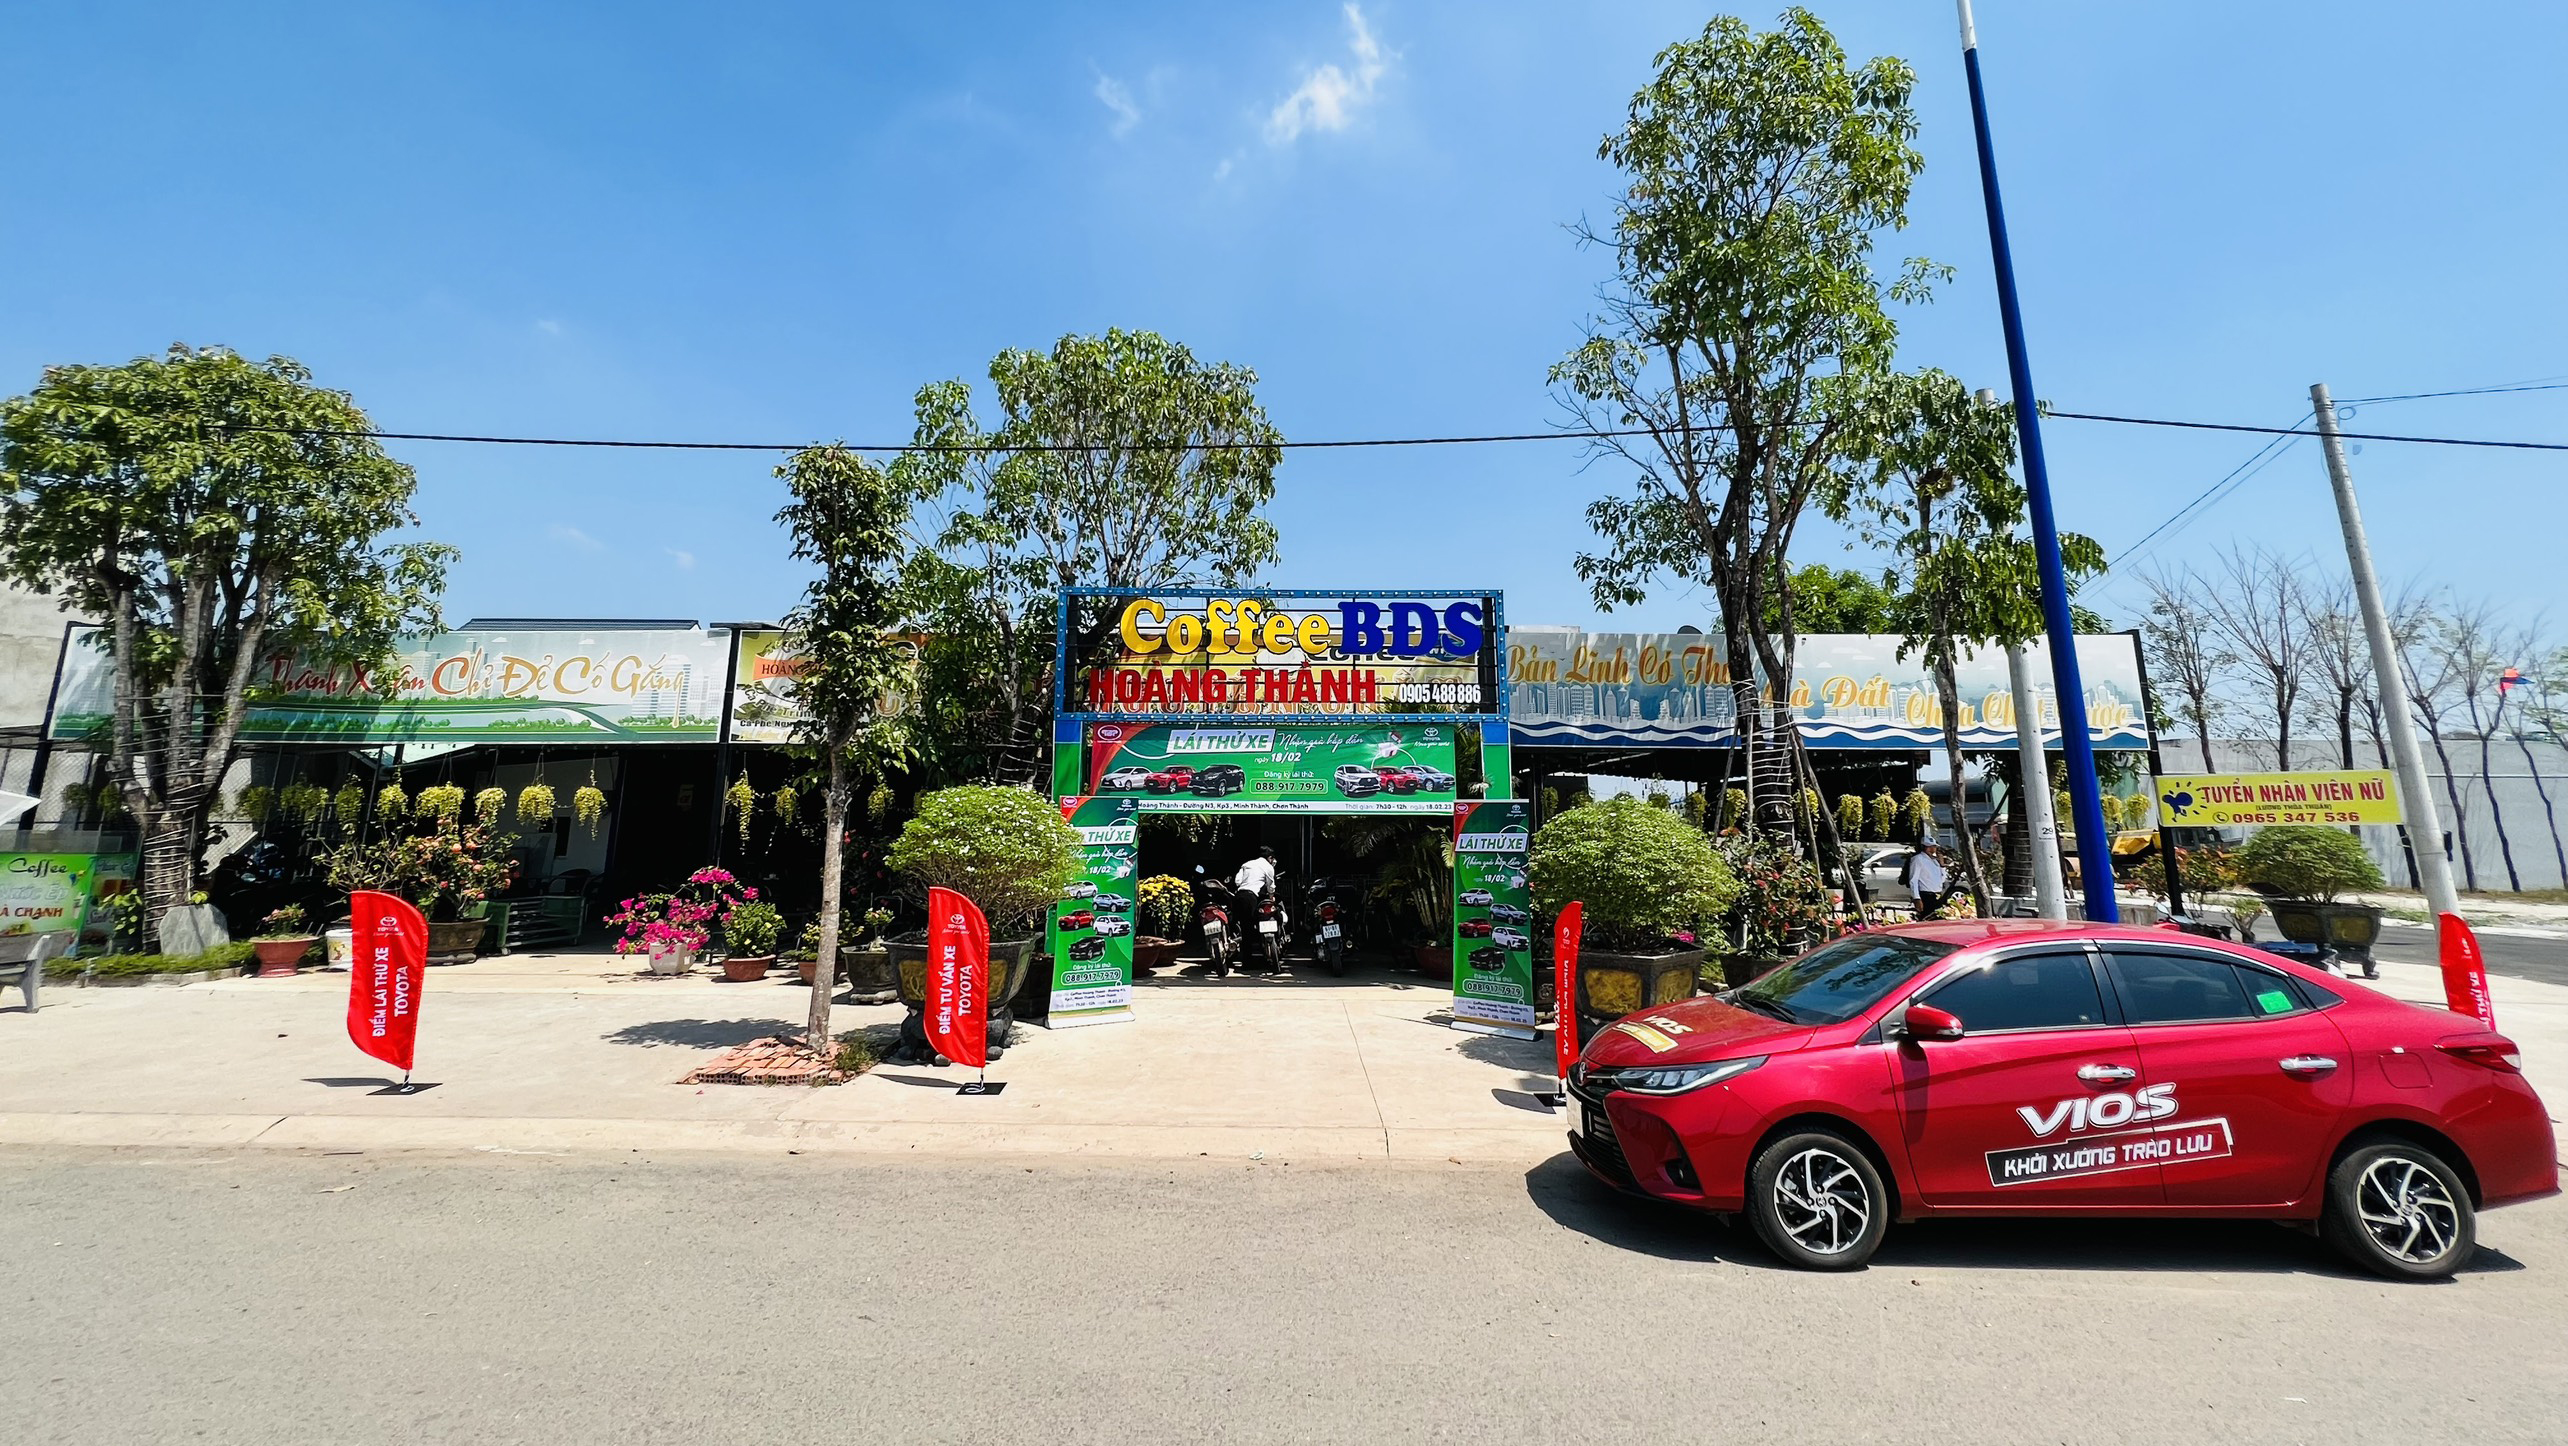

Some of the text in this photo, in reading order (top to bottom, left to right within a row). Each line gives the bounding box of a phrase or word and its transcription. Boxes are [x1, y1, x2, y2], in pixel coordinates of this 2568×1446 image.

[1120, 599, 1330, 655] Coffee
[1338, 602, 1483, 656] BĐS
[1565, 644, 1631, 684] Lĩnh
[1638, 645, 1673, 684] Có
[346, 658, 426, 696] Xân
[432, 647, 492, 695] Chỉ
[497, 654, 554, 697] Để
[553, 651, 610, 695] Cố
[611, 652, 685, 728] Gắng
[1089, 656, 1376, 704] HOÀNG THÀNH
[1822, 676, 1892, 709] Đất
[1399, 684, 1430, 704] 0905
[1906, 692, 1977, 727] Cha
[1173, 732, 1203, 750] LÁI
[1207, 731, 1246, 750] THỬ
[1245, 735, 1269, 749] XE
[1271, 752, 1302, 764] 18/02
[1255, 782, 1324, 791] 088.917.7979
[2201, 778, 2385, 804] TUYỂN NHÂN VIÊN NỮ
[2232, 811, 2360, 823] 0965 347 536
[1088, 828, 1131, 842] THỬ XE
[1459, 835, 1523, 850] LÁI THỬ XE
[8, 858, 68, 877] Coffee
[1090, 866, 1111, 875] 18/02
[1484, 874, 1506, 883] 18/02
[374, 947, 389, 962] XE
[944, 945, 956, 961] XE
[372, 963, 389, 989] THỬ
[938, 962, 954, 987] VẤN
[372, 989, 387, 1007] LÁI
[394, 965, 410, 1017] TOYOTA
[939, 987, 951, 1006] TƯ
[958, 964, 973, 1017] TOYOTA
[368, 1012, 387, 1037] ĐIỂM
[935, 1006, 951, 1035] ĐIỂM
[2017, 1083, 2178, 1137] VIOS
[2005, 1153, 2047, 1177] KHỞI
[2052, 1147, 2116, 1171] XƯỚNG
[2121, 1138, 2171, 1161] TRÀO
